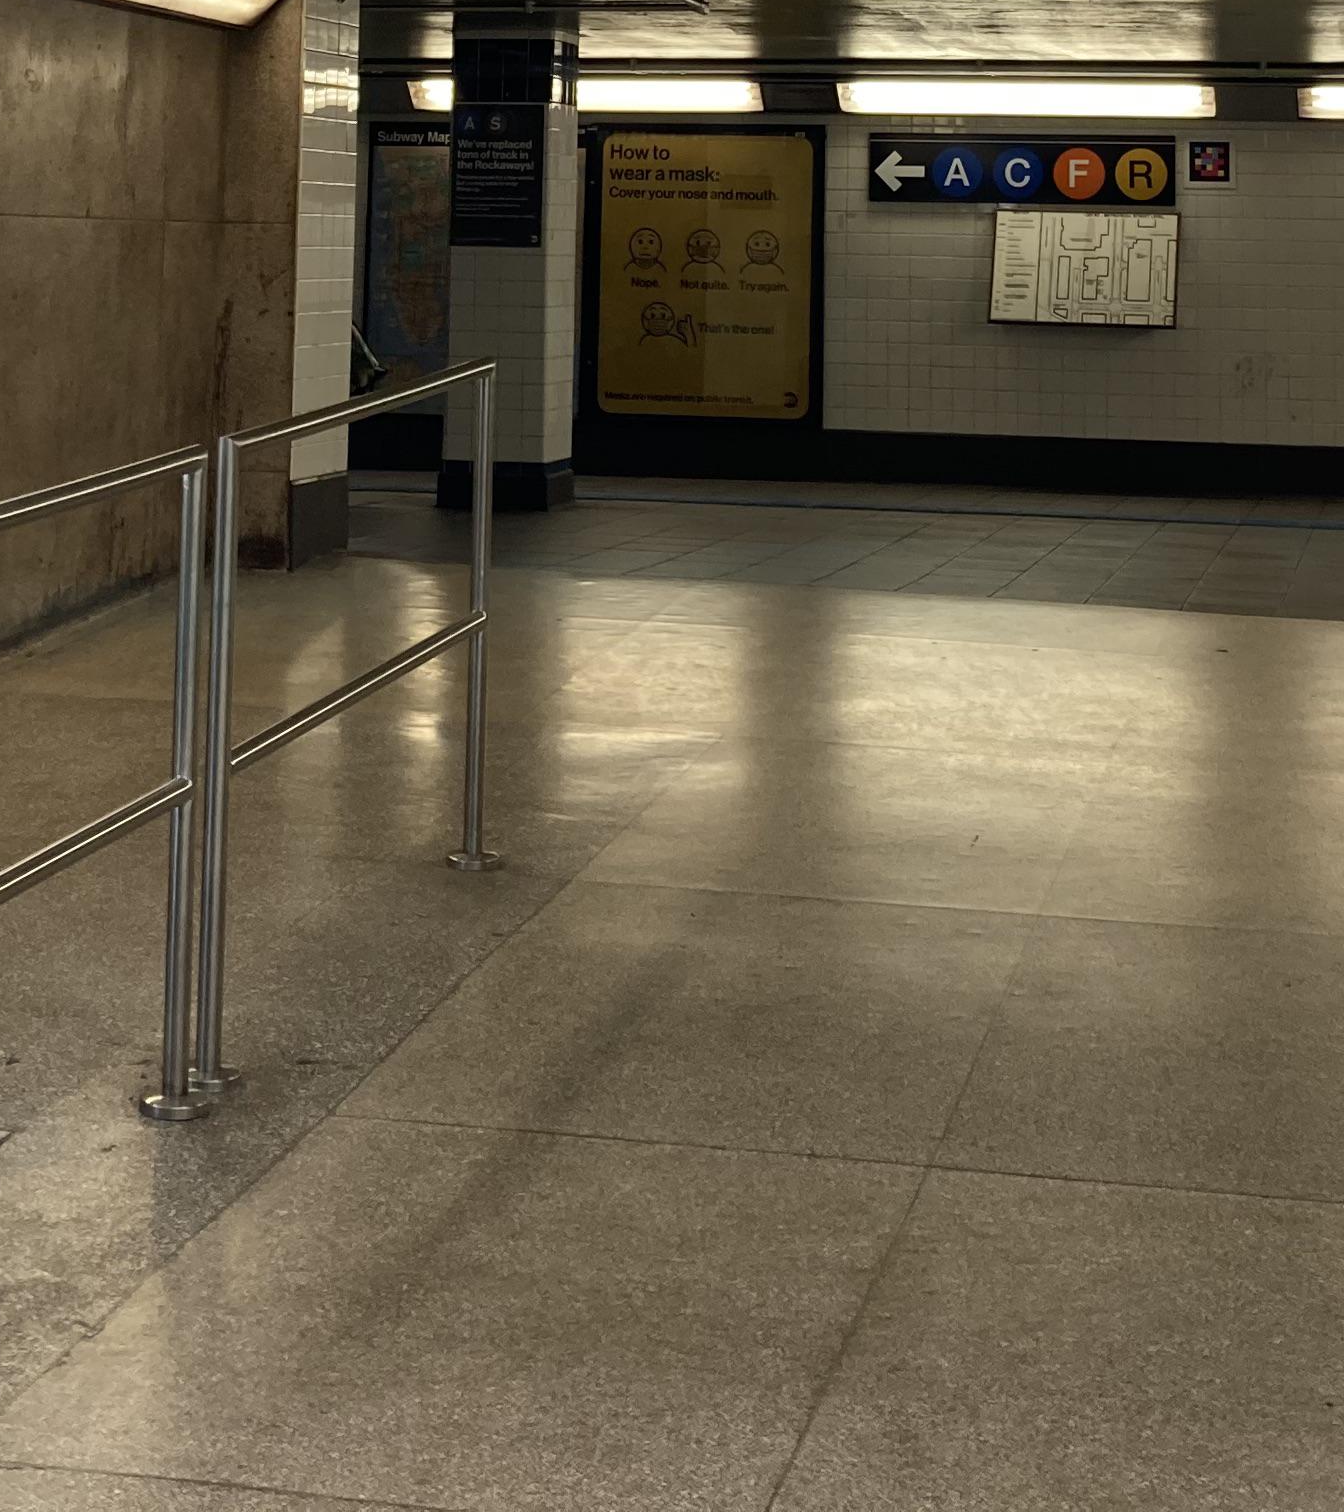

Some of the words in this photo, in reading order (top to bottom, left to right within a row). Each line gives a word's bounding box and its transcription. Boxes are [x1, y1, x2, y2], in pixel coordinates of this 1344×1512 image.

[463, 116, 476, 130] A
[489, 116, 501, 130] S
[376, 130, 424, 145] Subway
[427, 131, 450, 144] Map
[457, 139, 487, 149] We've
[488, 139, 533, 150] replaced
[457, 150, 480, 159] tons
[480, 150, 491, 159] of
[492, 150, 519, 159] track
[519, 150, 529, 159] in
[610, 144, 649, 160] How
[653, 145, 670, 160] to
[457, 160, 473, 170] the
[474, 160, 534, 172] Rockaways!
[609, 168, 652, 180] wear
[655, 169, 665, 180] a
[669, 166, 720, 182] mask:
[943, 158, 970, 187] A
[1004, 158, 1031, 187] C
[1069, 159, 1090, 187] F
[1129, 160, 1153, 189] R
[609, 186, 646, 198] Cover
[648, 189, 674, 200] your
[678, 189, 708, 199] nose
[710, 189, 733, 200] and
[735, 190, 778, 201] mouth.
[631, 277, 660, 288] Nope.
[680, 279, 699, 289] Not
[702, 280, 730, 290] quite.
[740, 280, 756, 291] Try
[756, 283, 789, 293] again.
